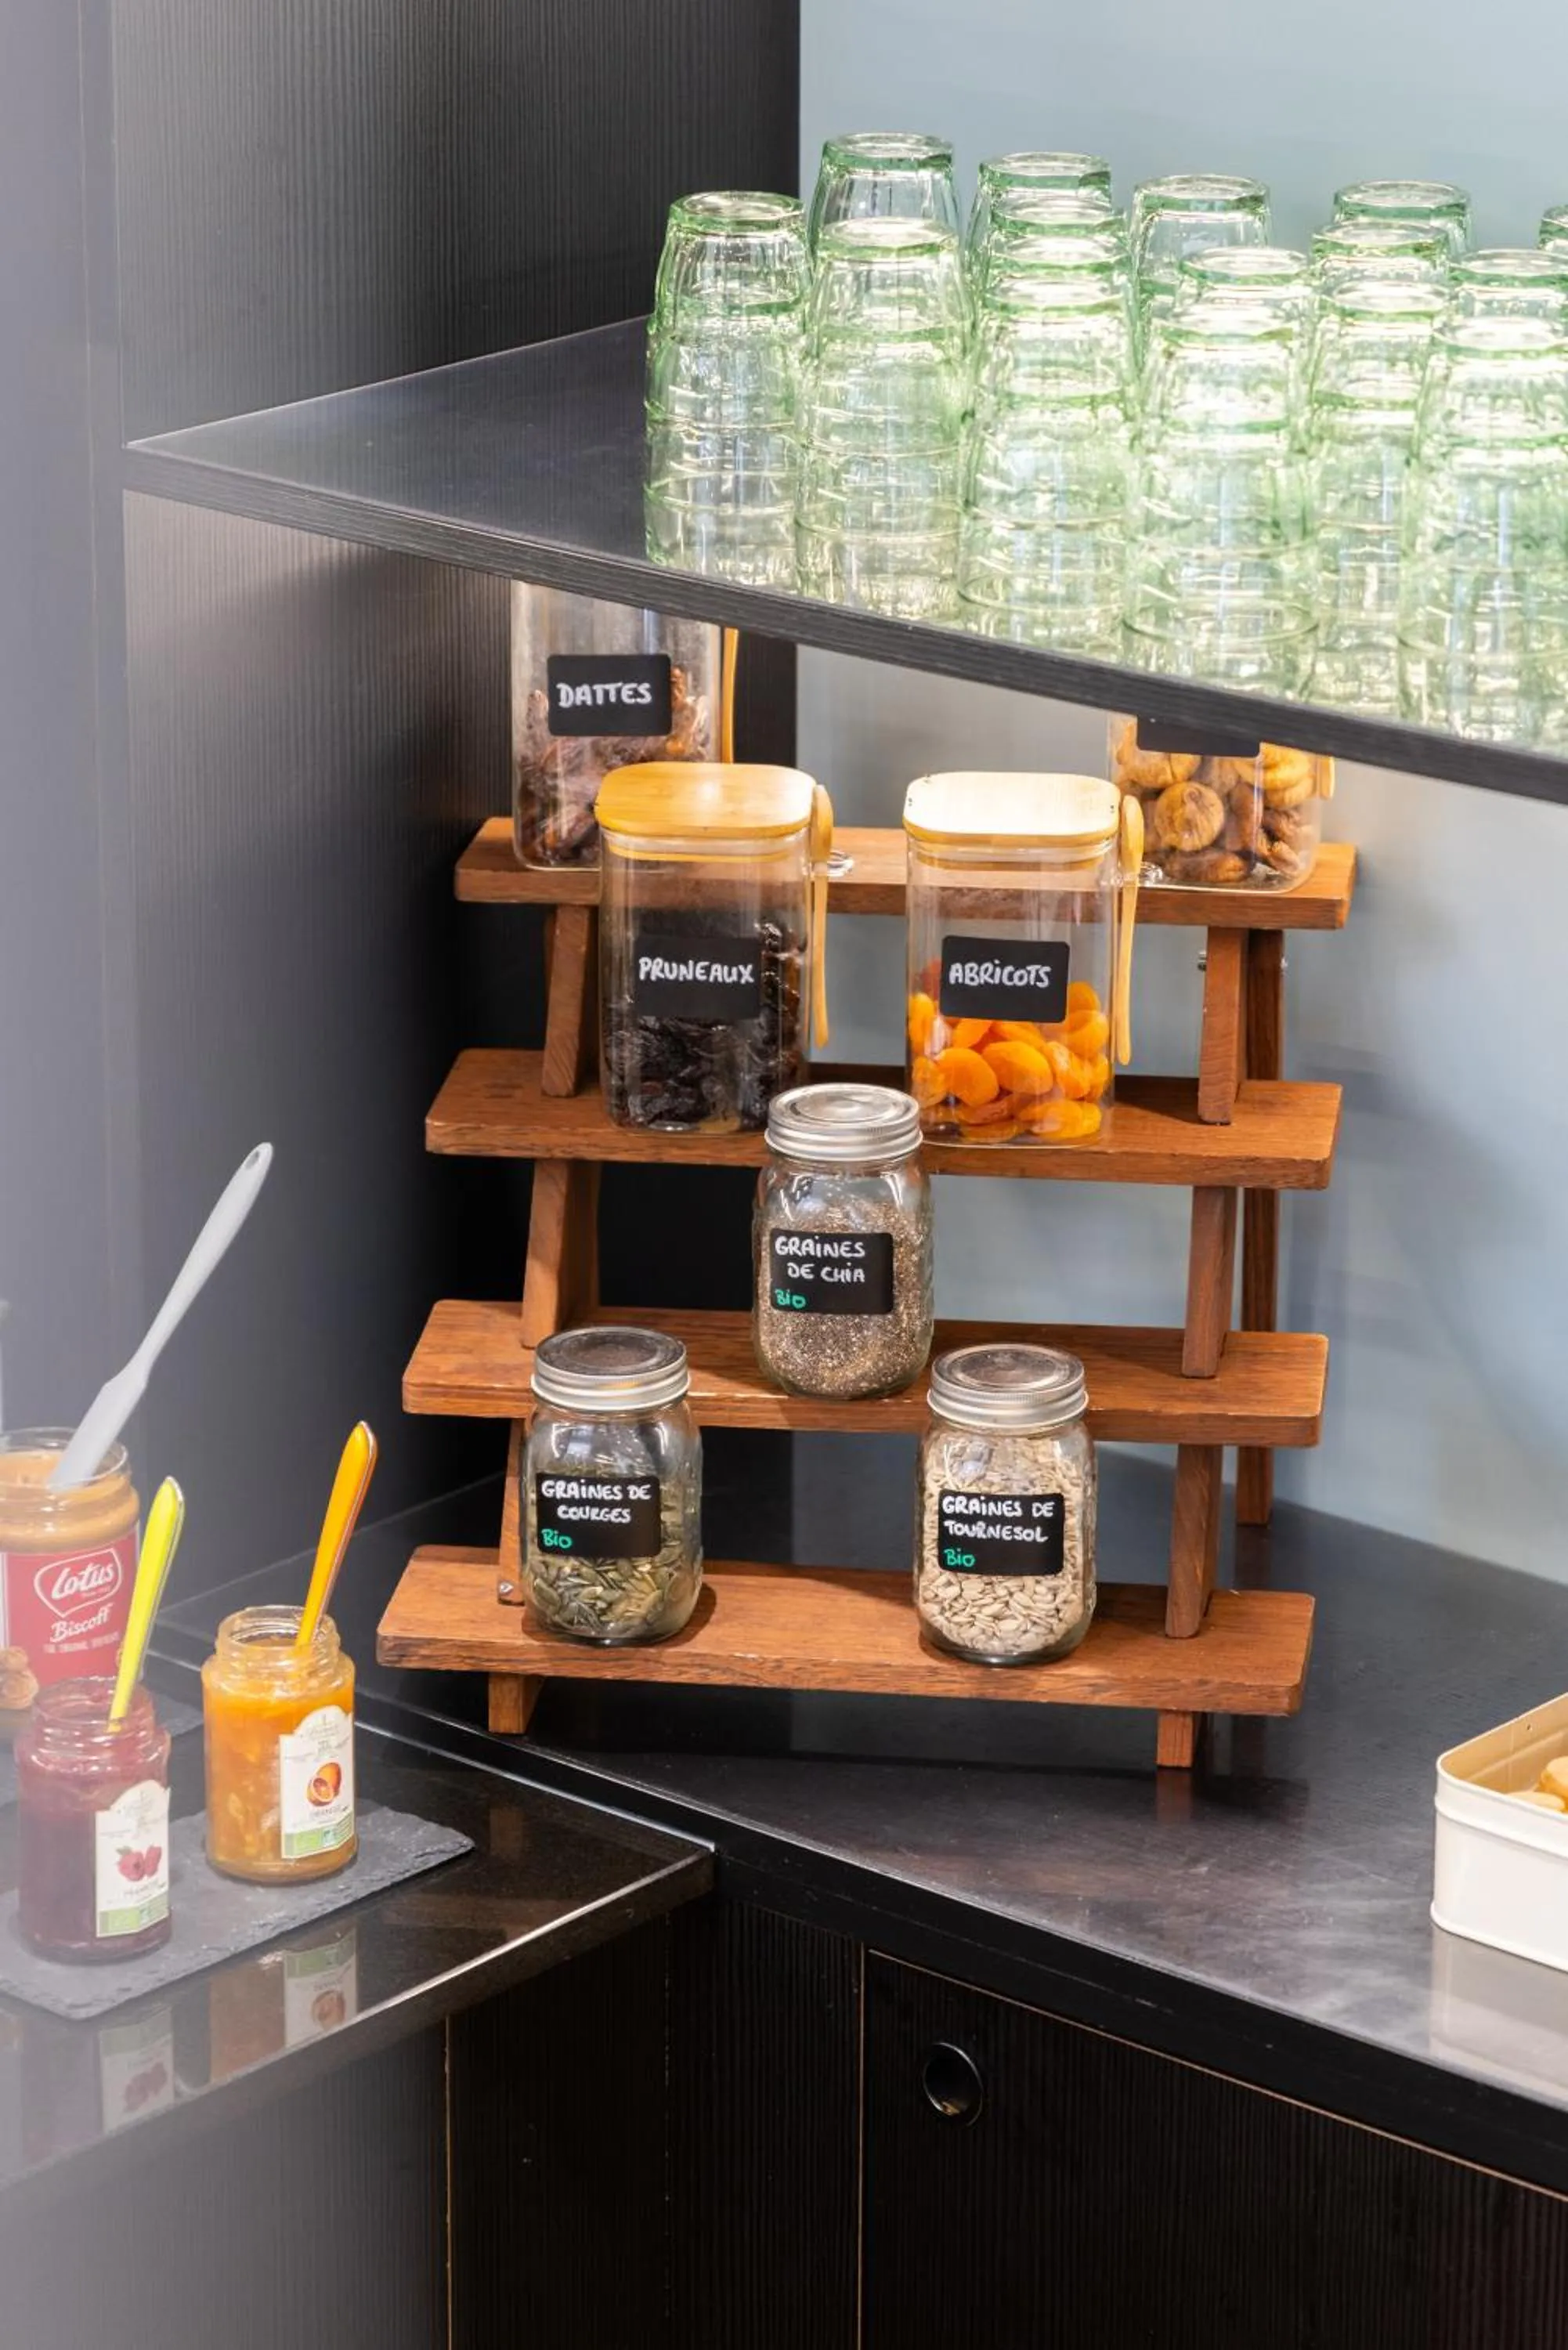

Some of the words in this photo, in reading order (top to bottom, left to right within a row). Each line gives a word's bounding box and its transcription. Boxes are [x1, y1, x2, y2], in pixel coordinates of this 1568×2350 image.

[555, 682, 652, 708] DATTES
[638, 956, 754, 984] PRUNEAUX
[787, 1262, 815, 1279] DE
[627, 1484, 652, 1500] DE
[557, 1505, 631, 1524] COURGES
[1031, 1502, 1055, 1517] DE
[943, 1520, 1049, 1542] TOURNESOL
[51, 1563, 114, 1600] Lotus
[50, 1603, 114, 1642] Biscoff
